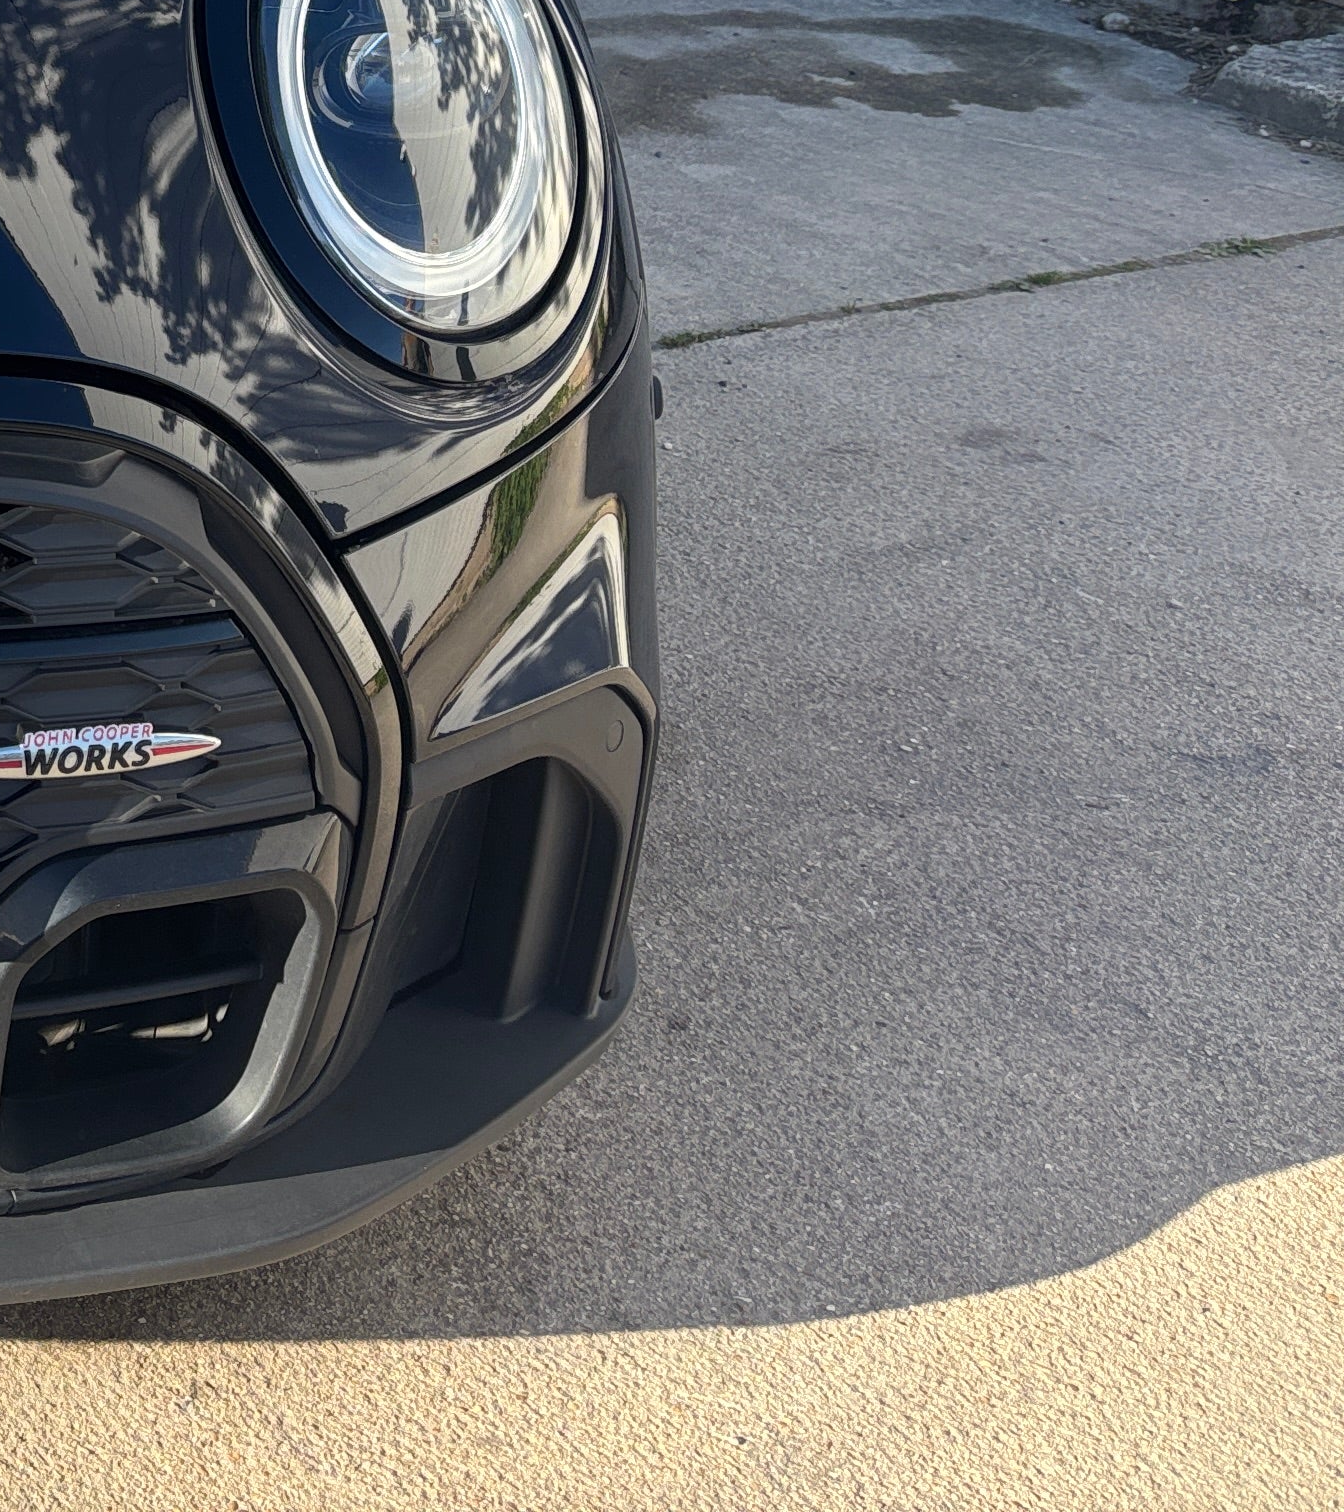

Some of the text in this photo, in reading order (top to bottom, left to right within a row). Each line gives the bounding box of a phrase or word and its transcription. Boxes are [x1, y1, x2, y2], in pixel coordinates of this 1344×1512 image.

[24, 723, 153, 748] JOHN COOPER
[24, 740, 153, 776] WORKS
